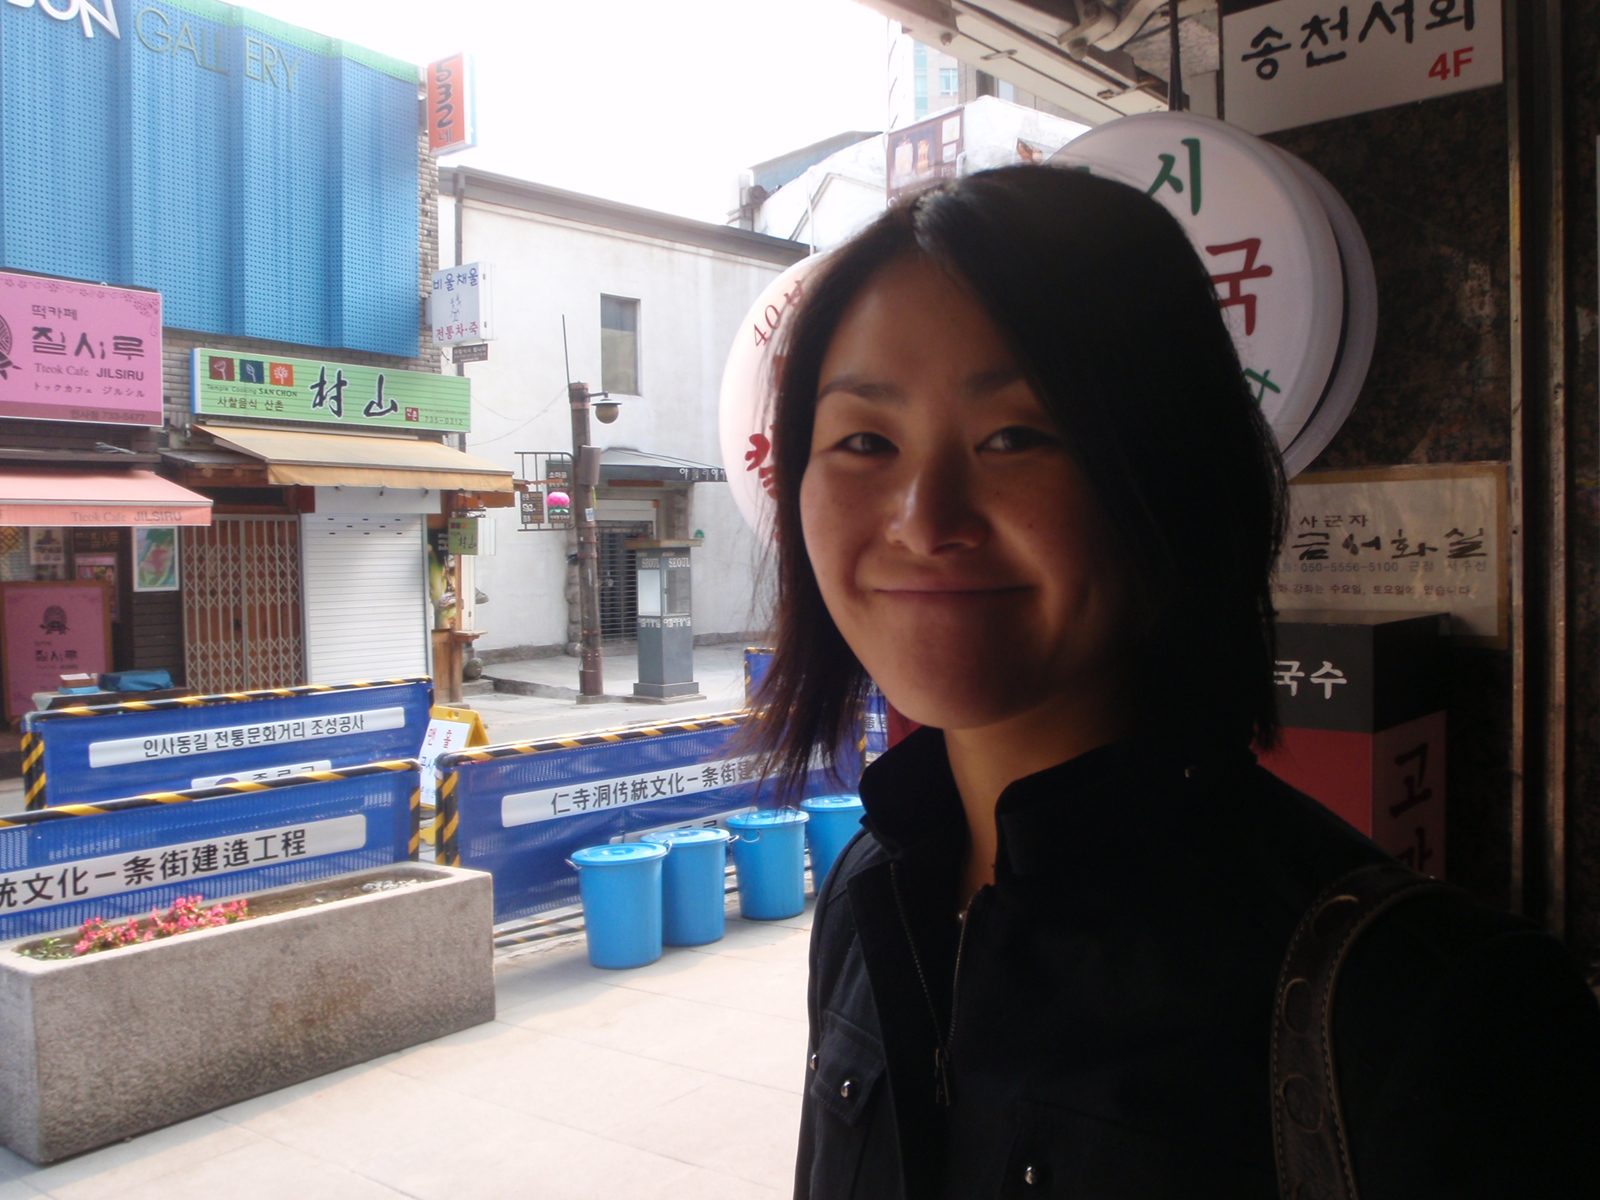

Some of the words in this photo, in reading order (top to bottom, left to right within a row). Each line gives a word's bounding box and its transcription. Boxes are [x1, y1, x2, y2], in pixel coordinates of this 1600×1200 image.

[5, 0, 120, 39] ON
[135, 8, 298, 91] GALLERY
[1428, 46, 1474, 80] 4F
[31, 304, 78, 320] 떡카페
[32, 325, 144, 361] 질시루
[66, 365, 89, 377] Cafe
[96, 367, 144, 381] JILSIRU
[134, 511, 182, 521] JILSIRU
[1273, 660, 1348, 700] 국수
[143, 732, 208, 759] 인사동길
[214, 719, 306, 751] 전통문화거리
[311, 714, 365, 737] 조성공사
